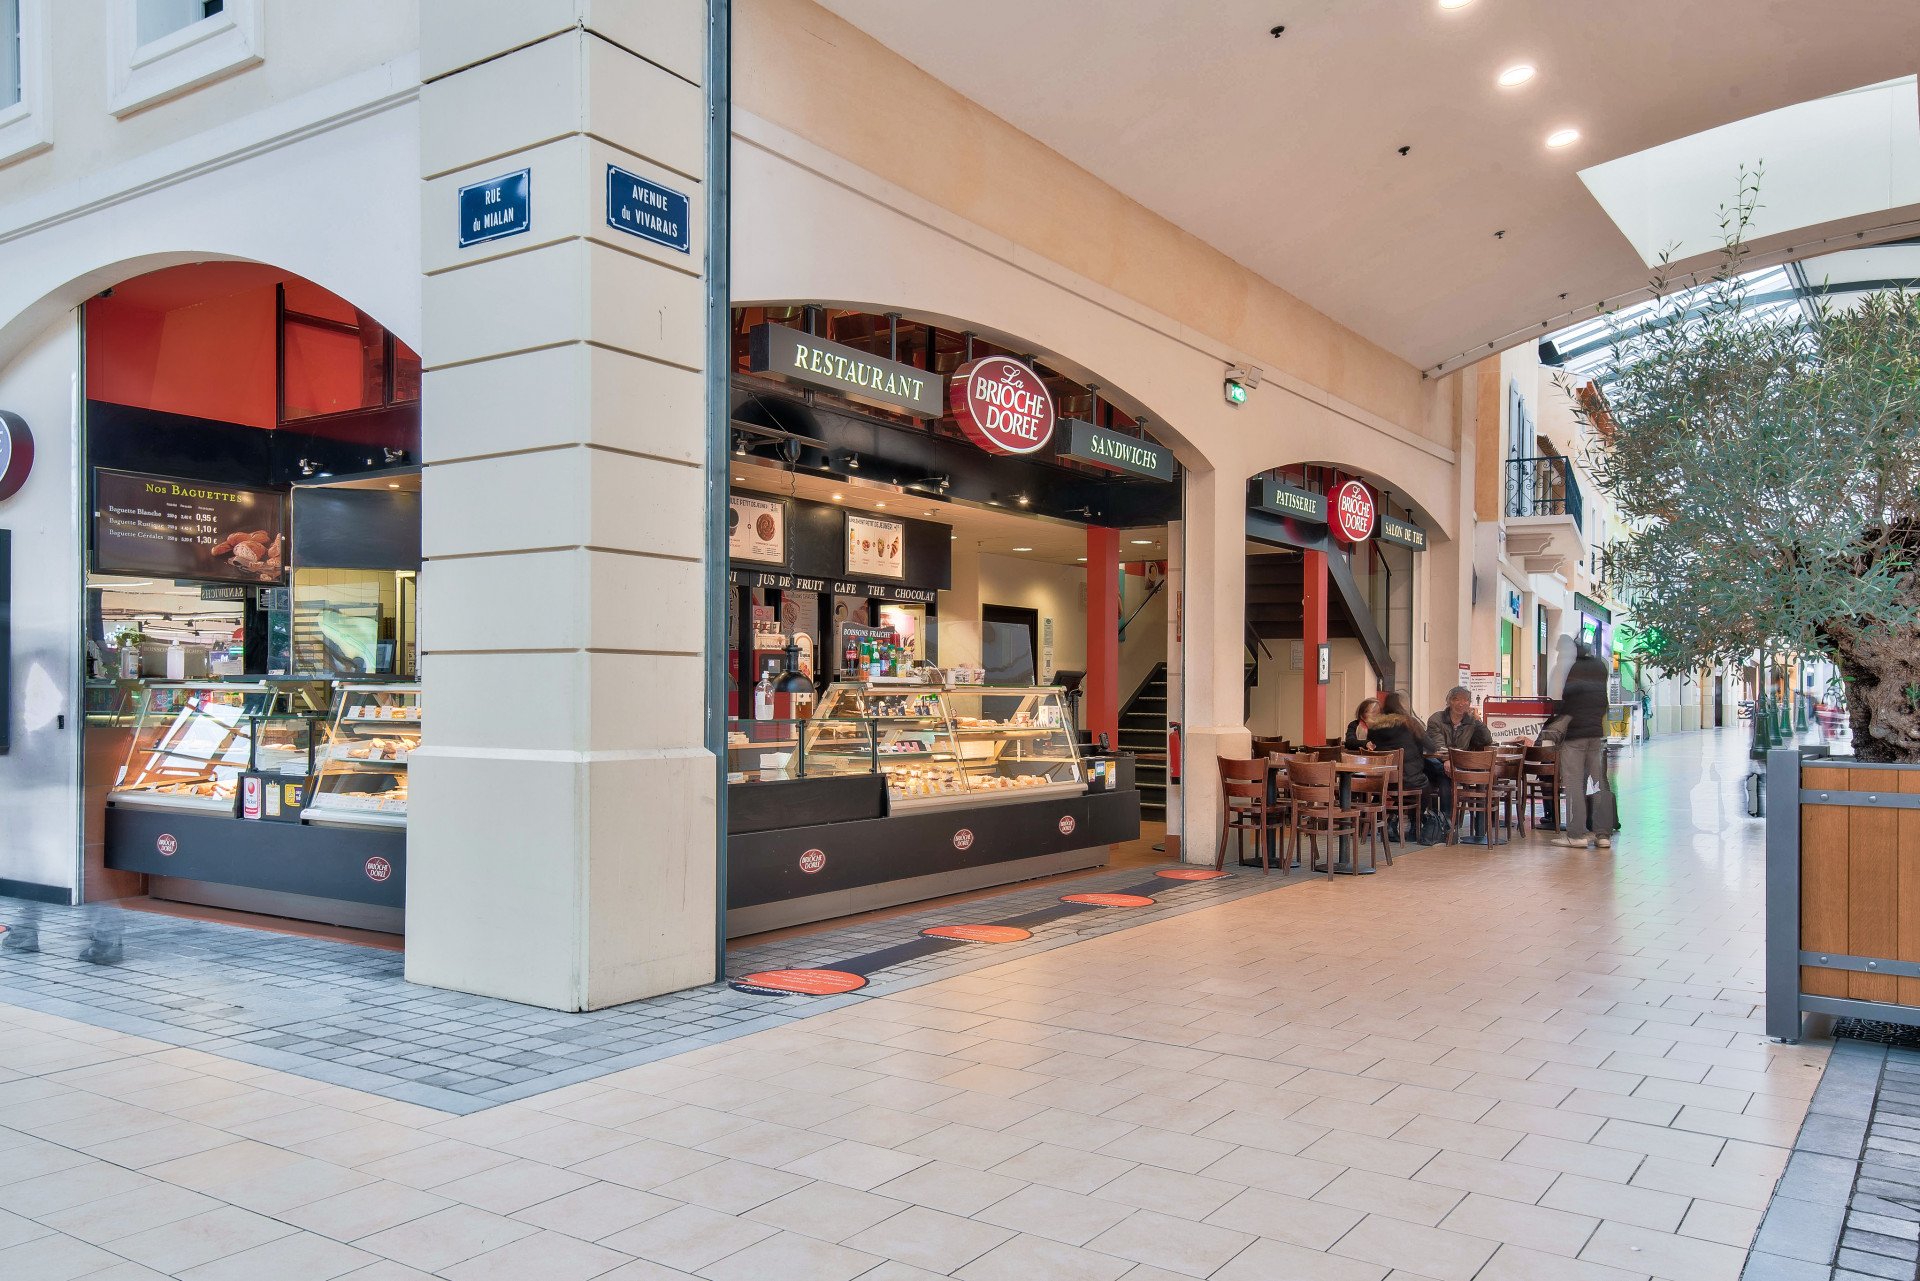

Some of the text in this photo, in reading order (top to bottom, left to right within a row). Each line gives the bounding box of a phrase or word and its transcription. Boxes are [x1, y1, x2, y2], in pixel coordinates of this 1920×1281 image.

[485, 187, 501, 205] RUE
[632, 184, 668, 212] AVENUE
[473, 207, 514, 232] du MIALAN
[621, 205, 678, 238] du VIVARAIS
[794, 343, 924, 402] RESTAURANT
[1000, 364, 1024, 389] La
[975, 376, 1045, 418] BRIOCHE
[986, 405, 1039, 441] DOREE
[1091, 434, 1157, 470] SANDWICHS
[1276, 489, 1317, 514] PATISSERIE
[1351, 485, 1362, 501] La
[109, 505, 136, 515] Baguette
[137, 508, 162, 517] Blanche
[195, 513, 211, 522] 0,95
[1341, 495, 1370, 518] BRIOCHE
[109, 517, 137, 526] Baguette
[137, 520, 164, 529] Rustique
[196, 524, 212, 534] 1,10
[1345, 513, 1368, 533] DOREE
[1385, 521, 1424, 546] SALON DE THE
[109, 529, 137, 538] Baguette
[196, 535, 212, 545] 1,30
[756, 573, 825, 591] JUS DE FRUIT
[834, 582, 935, 602] CAFE THE CHOCOLAT
[843, 628, 868, 637] BOISSONS
